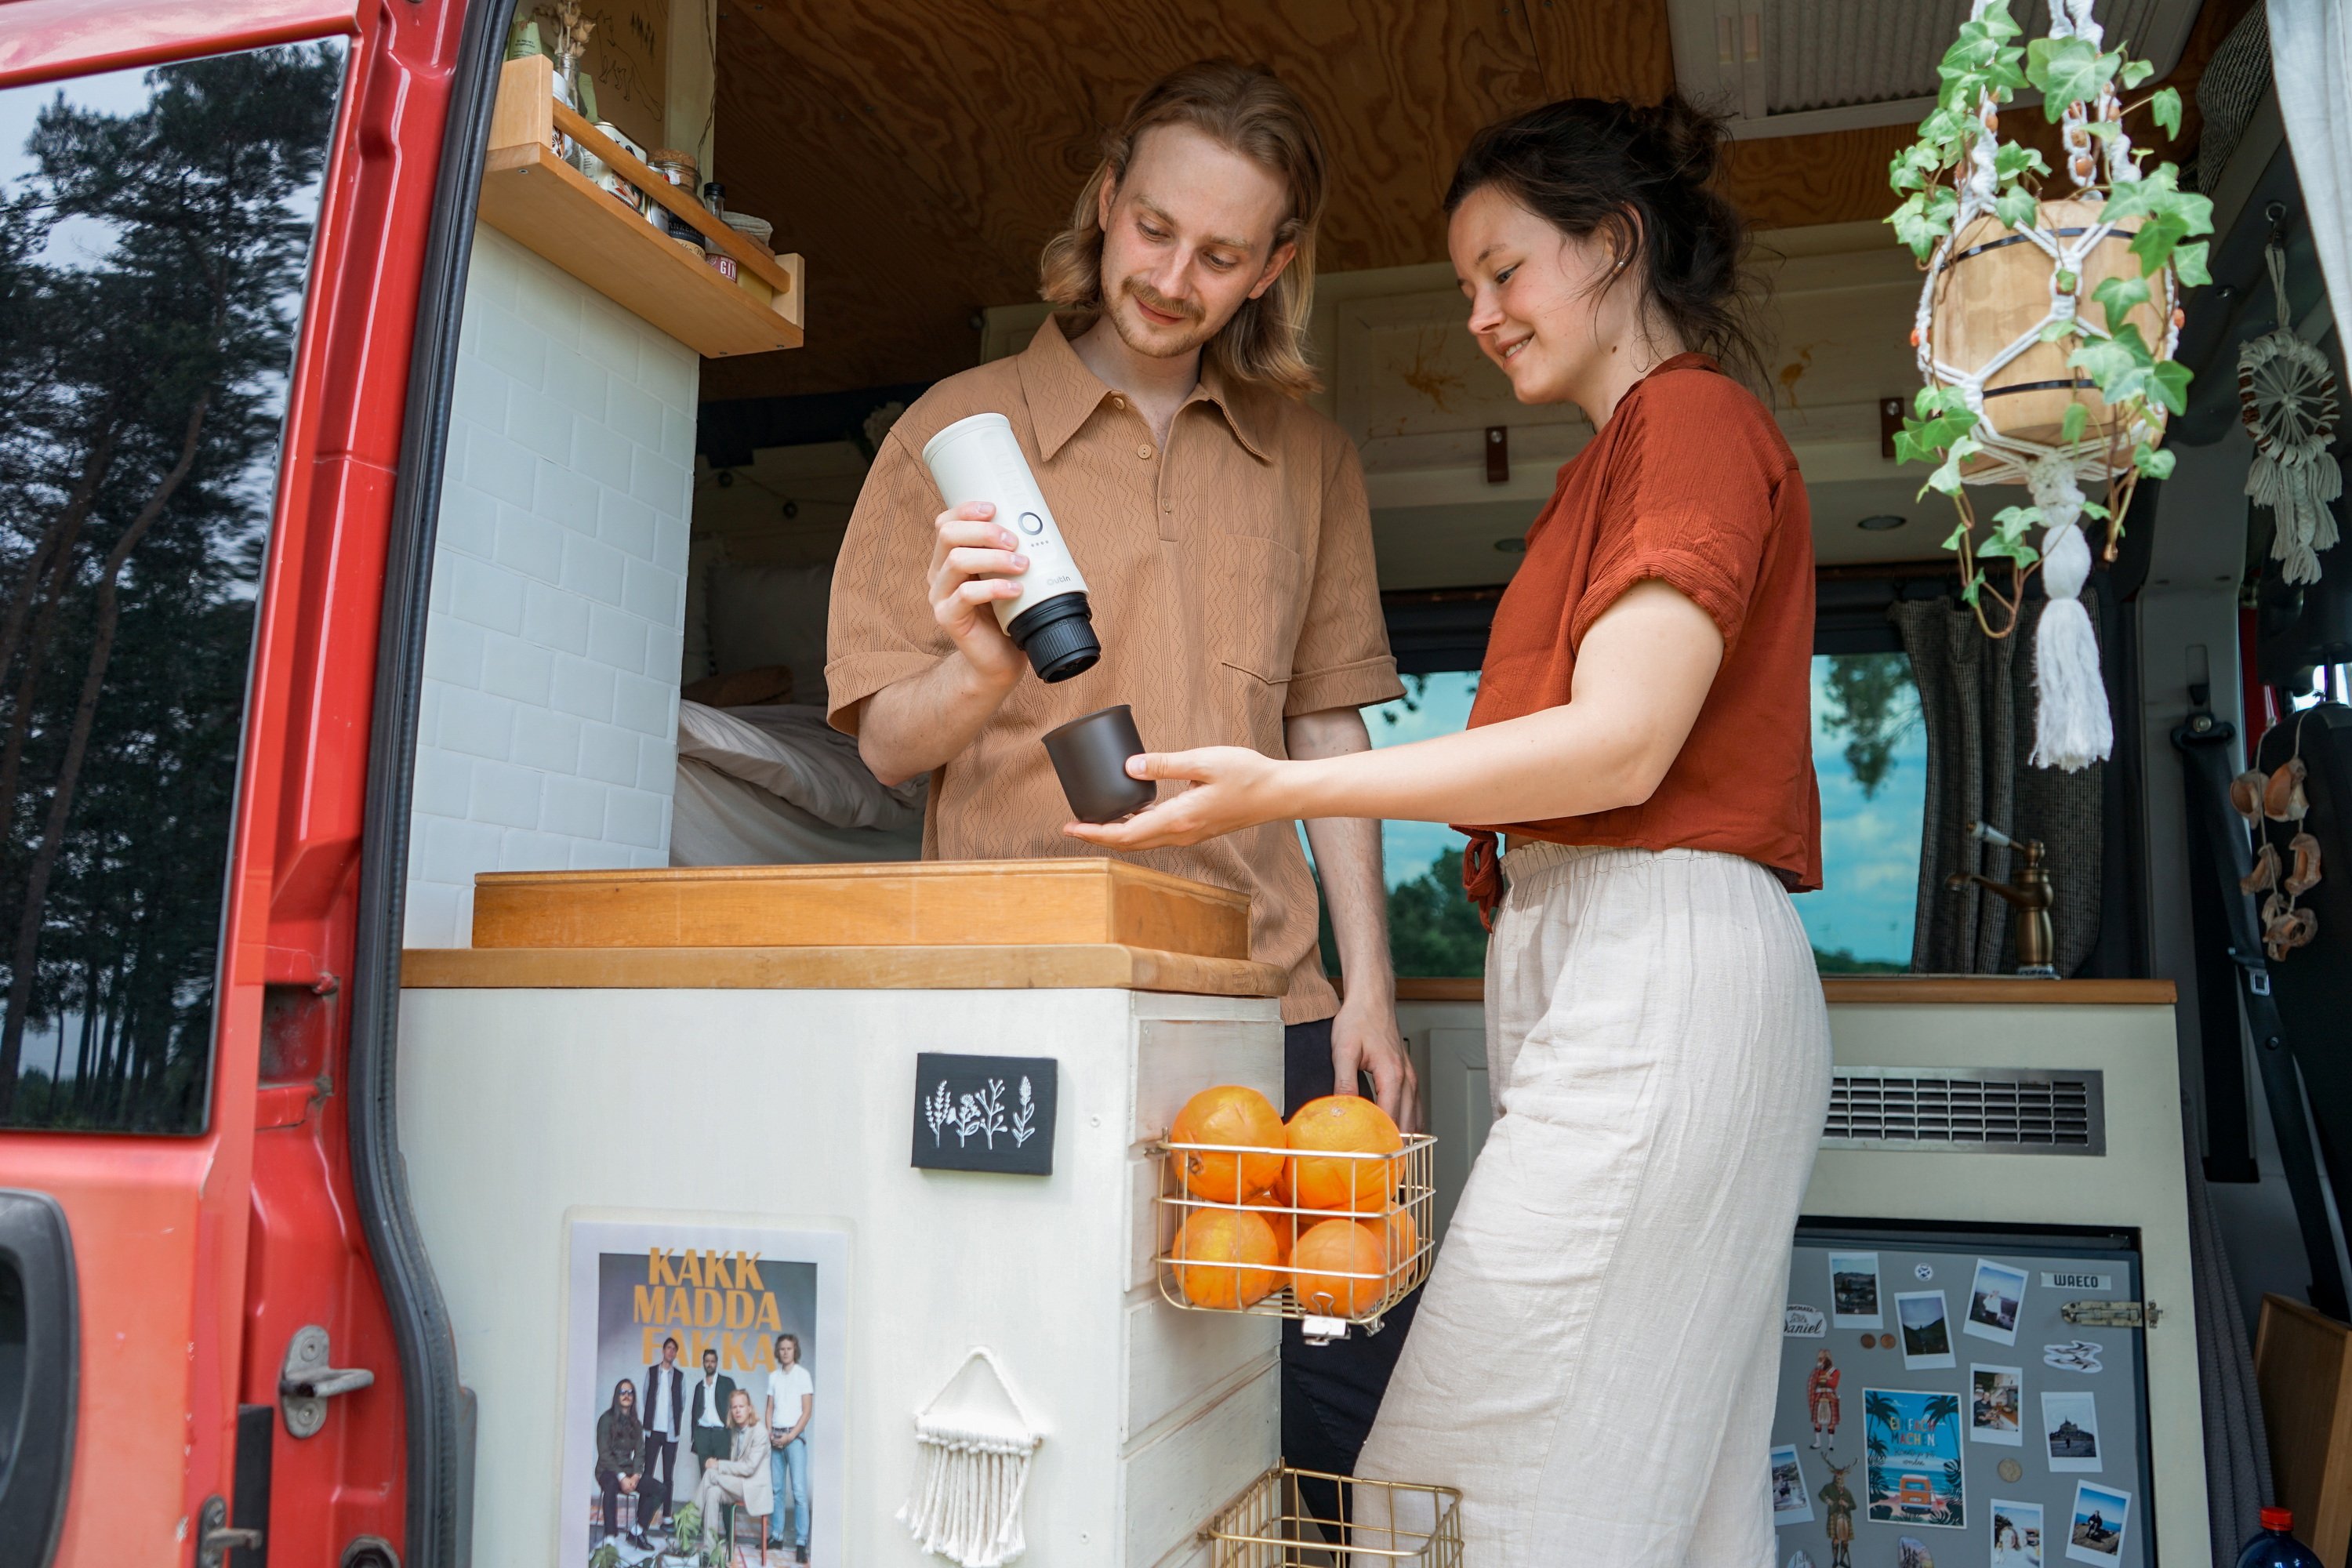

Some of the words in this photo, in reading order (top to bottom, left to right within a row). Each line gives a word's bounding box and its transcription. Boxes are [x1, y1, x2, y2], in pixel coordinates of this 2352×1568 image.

[720, 261, 736, 279] GIN
[1051, 619, 1073, 630] CLOSE
[648, 1247, 765, 1290] KAKK
[2054, 1274, 2099, 1288] WAECO
[633, 1285, 782, 1331] MADDA
[642, 1326, 778, 1374] FAKKA
[1890, 1416, 1936, 1432] EINFACH
